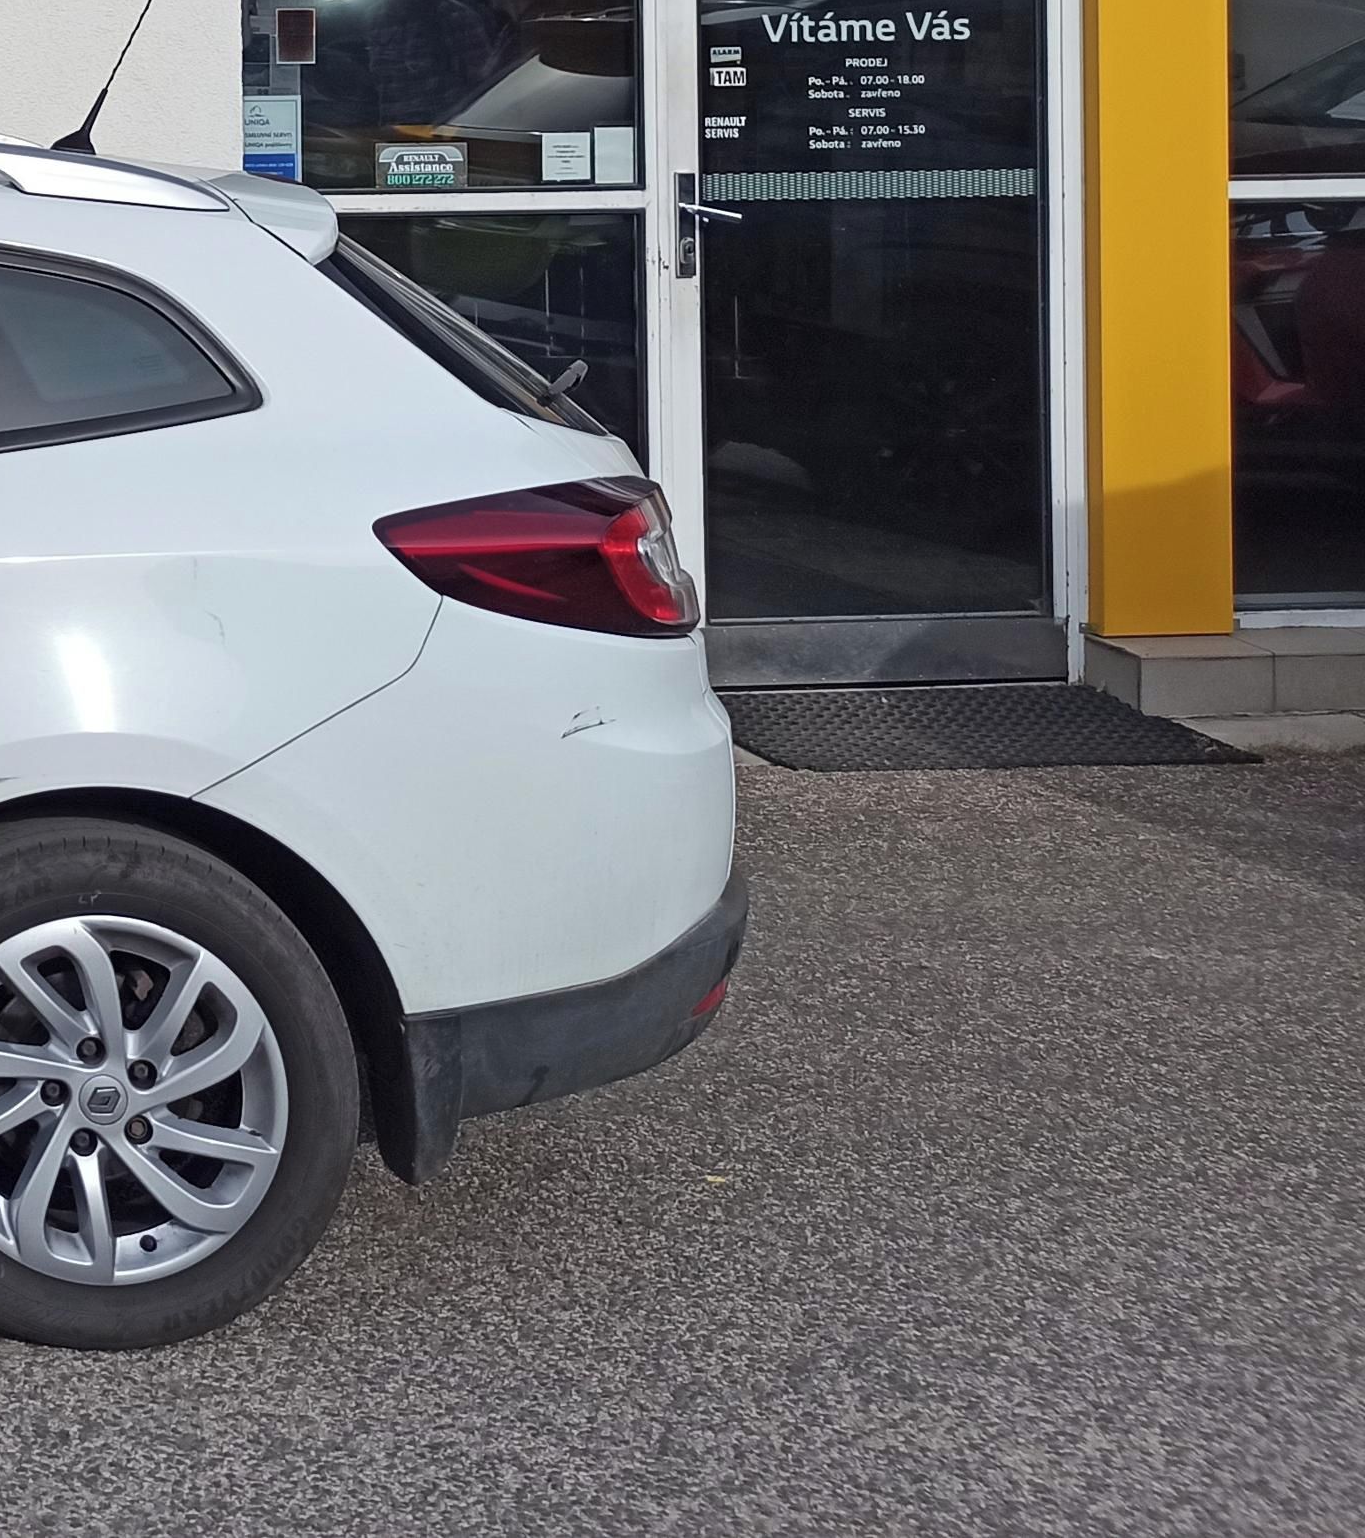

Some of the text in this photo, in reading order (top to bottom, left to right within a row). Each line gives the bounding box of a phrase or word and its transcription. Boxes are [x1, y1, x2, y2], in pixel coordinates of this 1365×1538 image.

[761, 10, 971, 43] Vítáme Vás
[845, 58, 888, 68] PRODEJ
[860, 88, 901, 98] zavřeno
[848, 108, 886, 118] SERVIS
[704, 116, 747, 127] RENAULT
[704, 127, 740, 139] SERVIS
[861, 138, 902, 148] zavřeno
